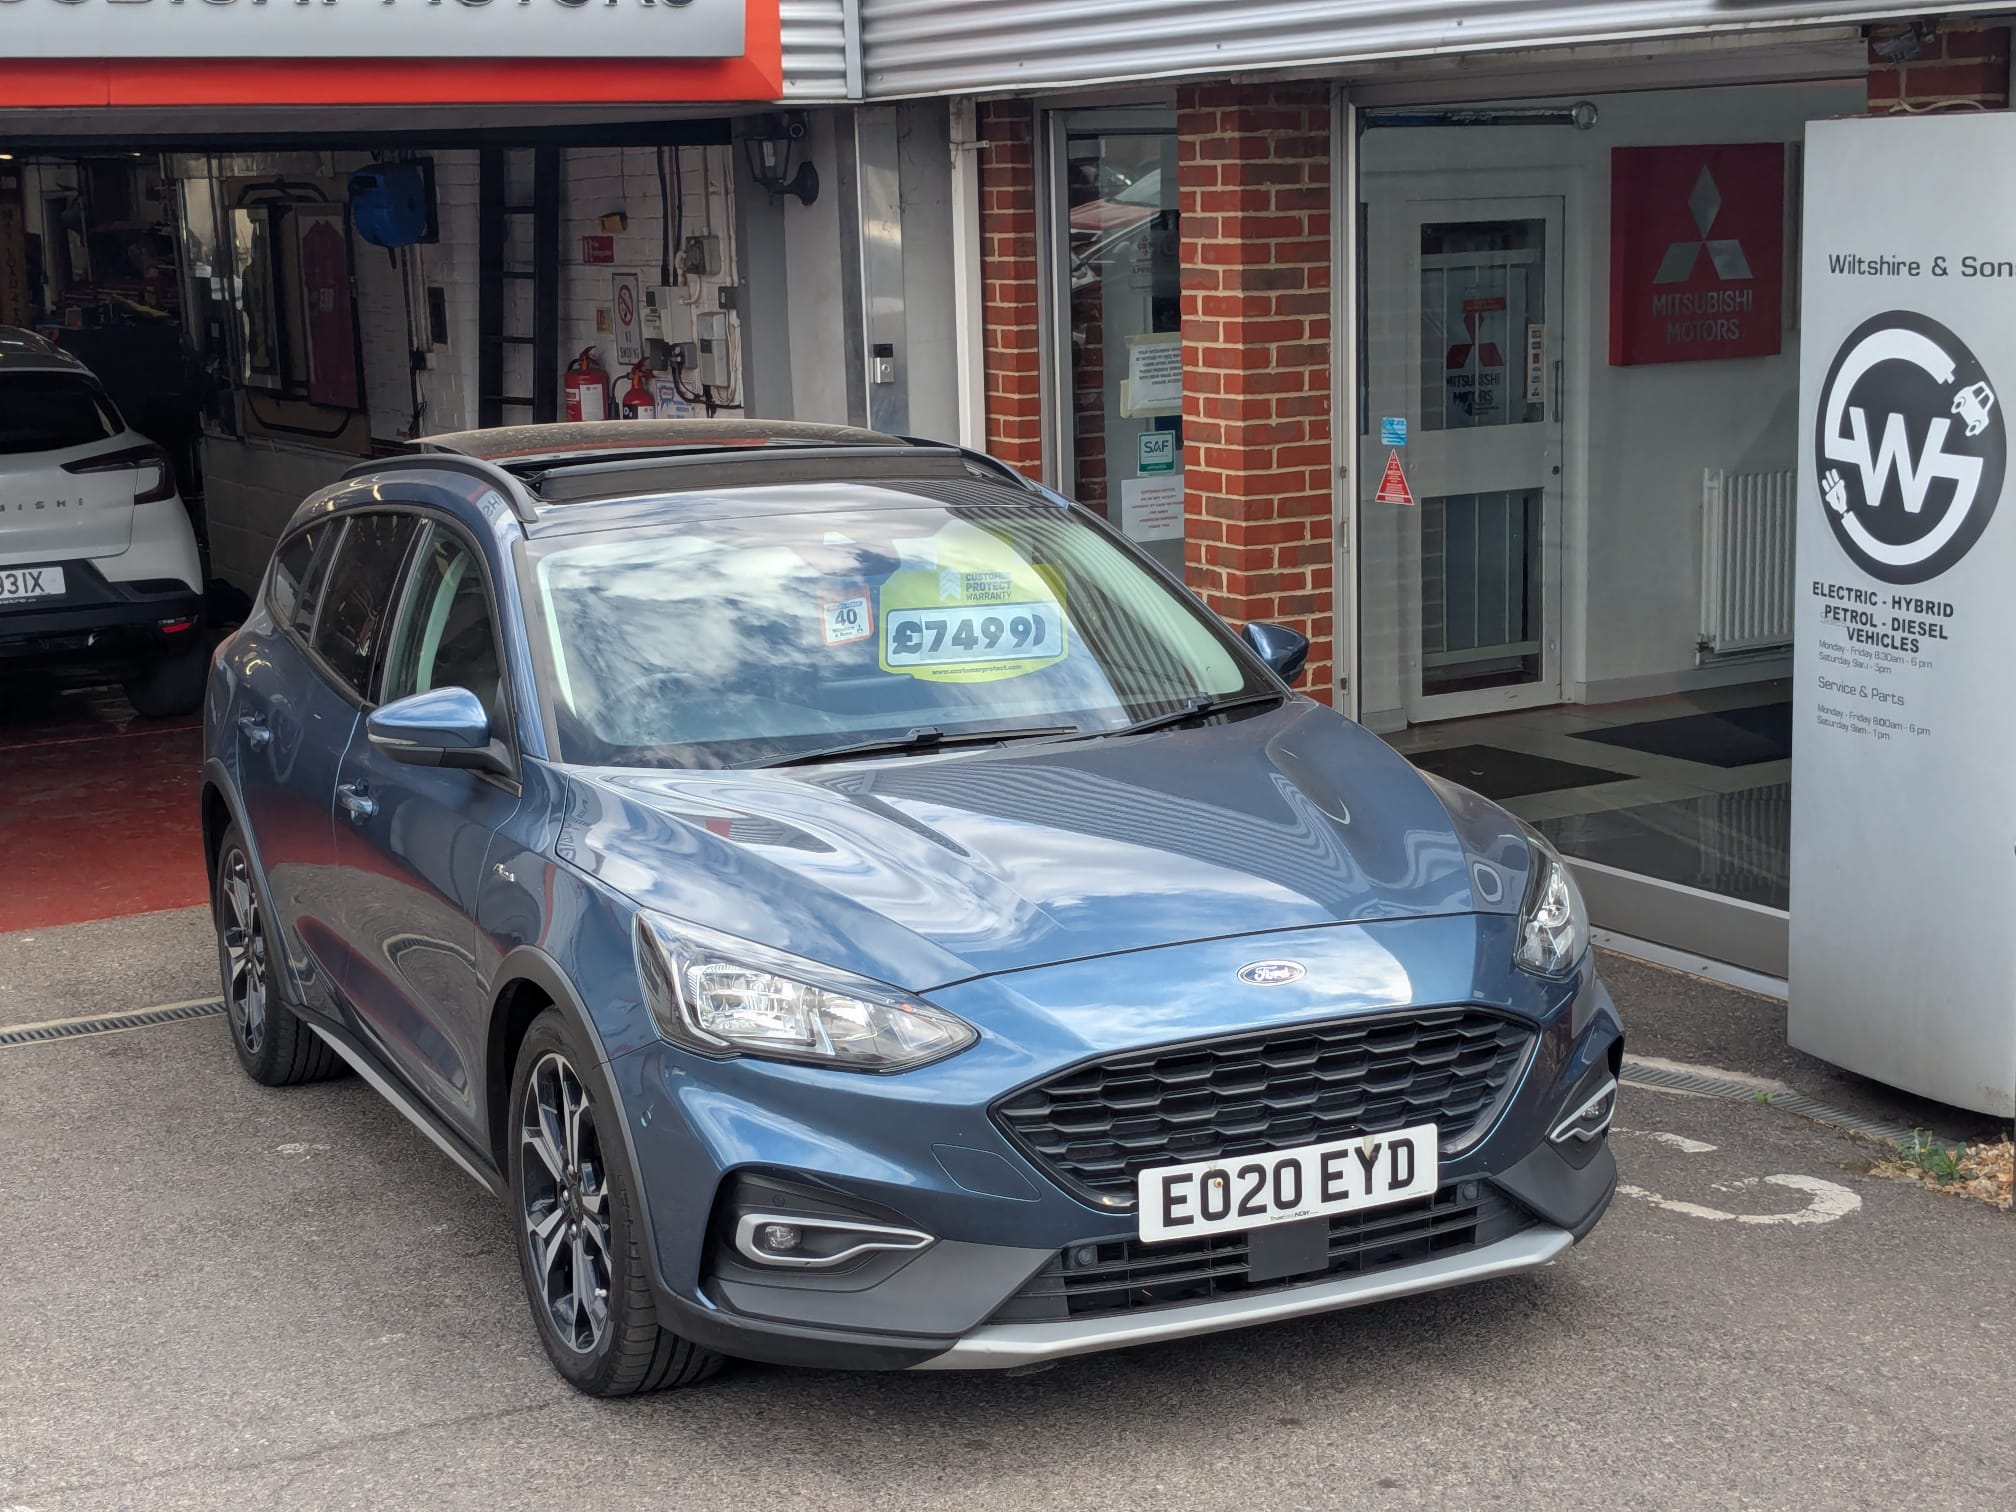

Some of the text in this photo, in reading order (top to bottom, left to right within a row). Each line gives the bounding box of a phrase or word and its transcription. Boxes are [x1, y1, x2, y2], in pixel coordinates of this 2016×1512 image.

[1828, 254, 2016, 278] Wiltshire & Son
[1652, 289, 1753, 316] MITSUBISHI
[1667, 319, 1740, 344] MOTORS
[1143, 440, 1169, 454] SAF
[966, 581, 1012, 592] PROTECT
[966, 591, 1012, 601] WARRANTY
[1812, 581, 1878, 606] ELECTRIC
[1891, 595, 1954, 618] HYBRID
[834, 608, 858, 625] 40
[1824, 604, 1878, 628] PETROL
[1891, 617, 1948, 640] DIESEL
[1819, 640, 1845, 654] Monday
[1851, 647, 1873, 660] Friday
[1847, 626, 1920, 653] VEHICLES
[1819, 652, 1850, 668] Saturday
[1818, 676, 1905, 706] Service & Parts
[1816, 716, 1849, 732] Saturday
[1817, 704, 1844, 719] Monday
[1849, 711, 1871, 725] Friday
[1254, 966, 1290, 981] Ford
[1161, 1137, 1415, 1228] EO20 EYD
